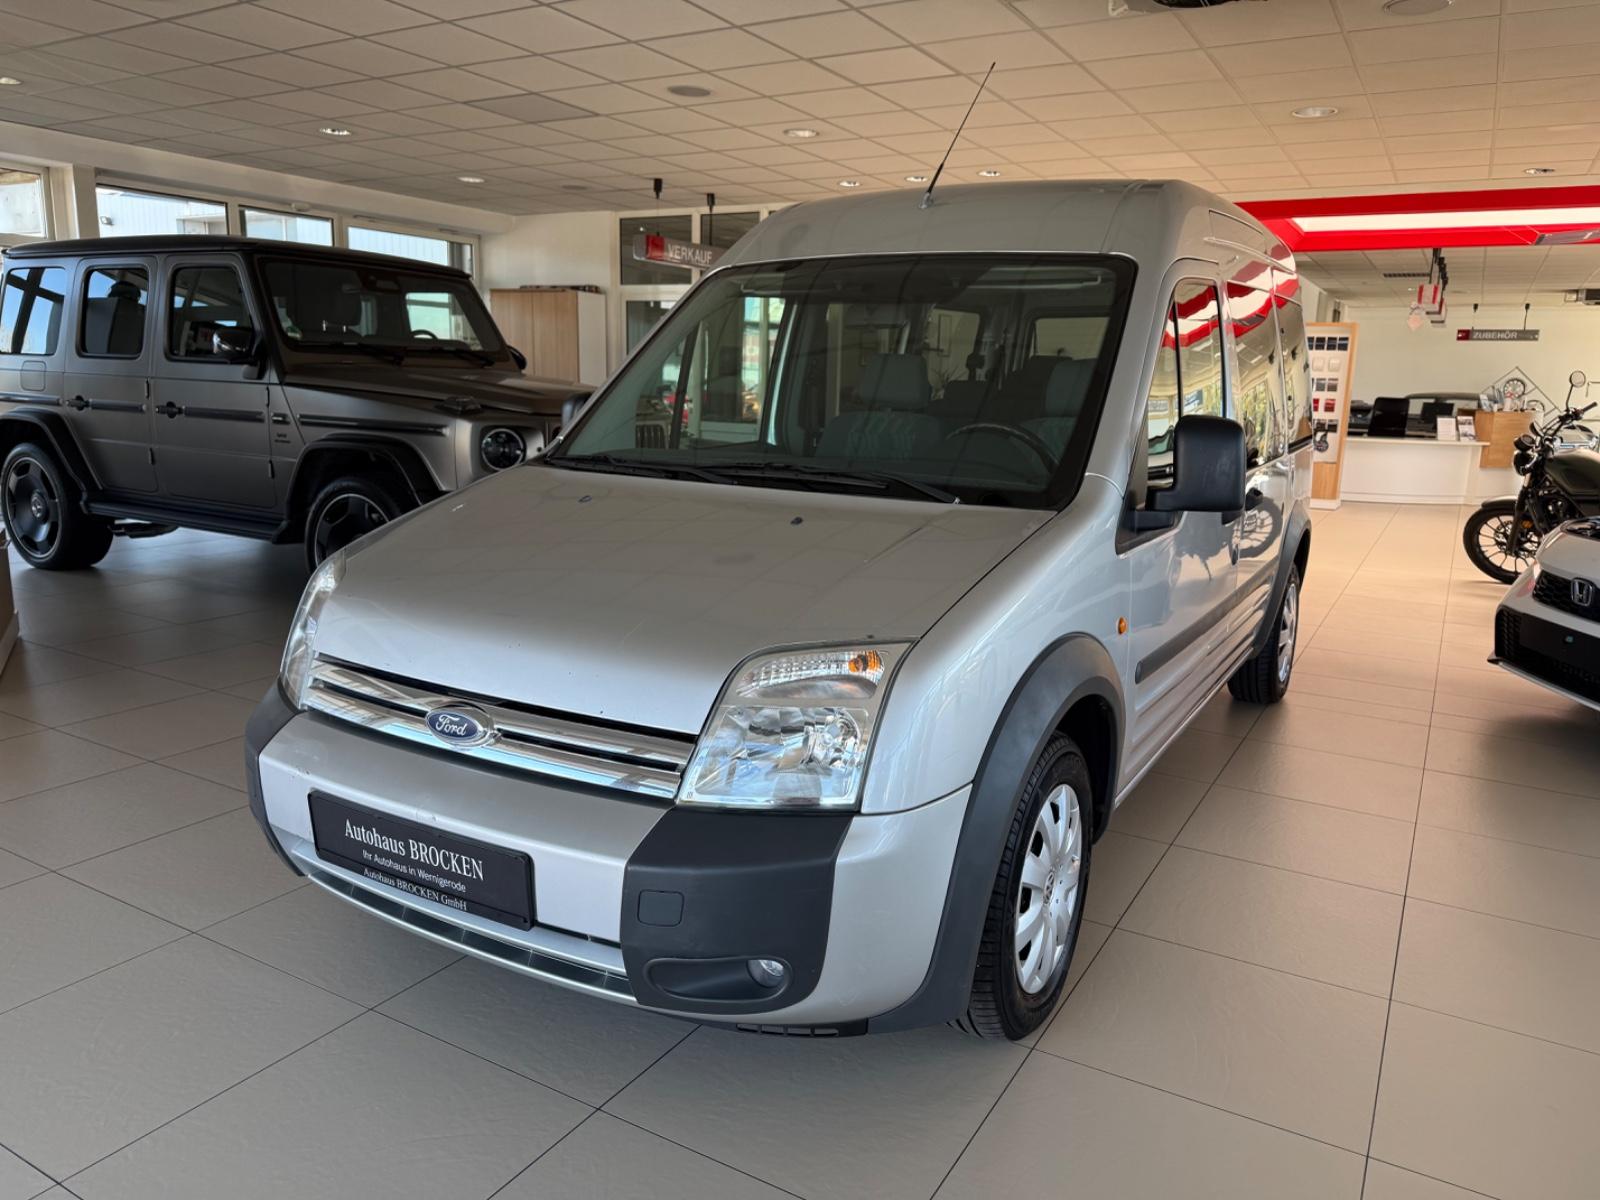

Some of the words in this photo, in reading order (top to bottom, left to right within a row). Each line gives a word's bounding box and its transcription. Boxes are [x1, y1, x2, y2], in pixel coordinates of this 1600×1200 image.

[667, 243, 713, 265] VERKAUF
[1473, 330, 1518, 339] ZUBEHÖR
[435, 714, 468, 736] Ford
[345, 818, 406, 856] Autohaus
[408, 839, 484, 881] BROCKEN
[362, 849, 372, 860] Ihr
[373, 854, 408, 873] Autohaus
[408, 865, 416, 876] in
[417, 869, 467, 892] Wernigerode
[363, 867, 396, 886] Autohaus
[397, 880, 439, 901] BROCKEN
[440, 894, 467, 911] GmbH
